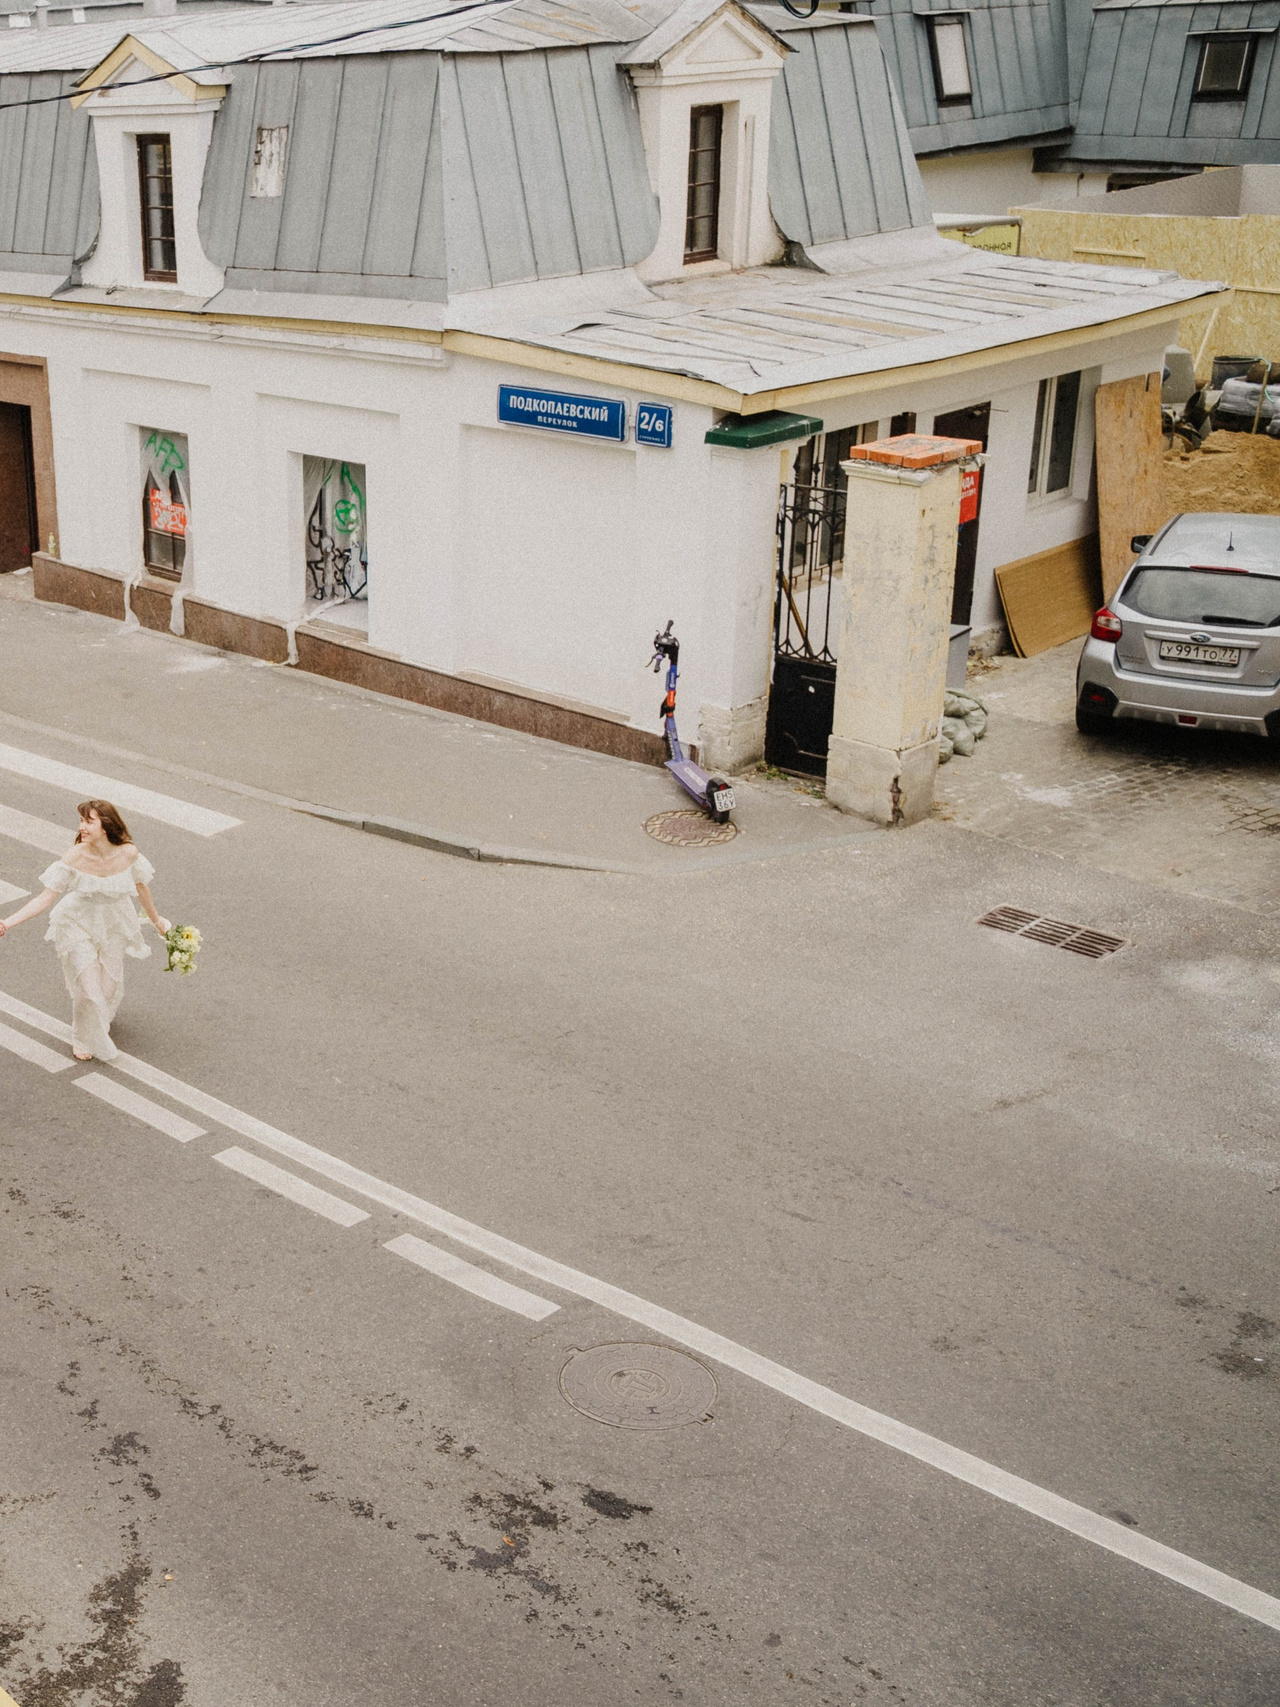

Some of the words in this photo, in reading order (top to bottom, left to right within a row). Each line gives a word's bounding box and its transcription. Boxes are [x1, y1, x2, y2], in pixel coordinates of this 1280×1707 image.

[509, 395, 609, 422] ПОДКОПАЕВСКИЙ
[537, 415, 578, 428] ПЕРЕУЛОК
[639, 411, 665, 432] 2/6
